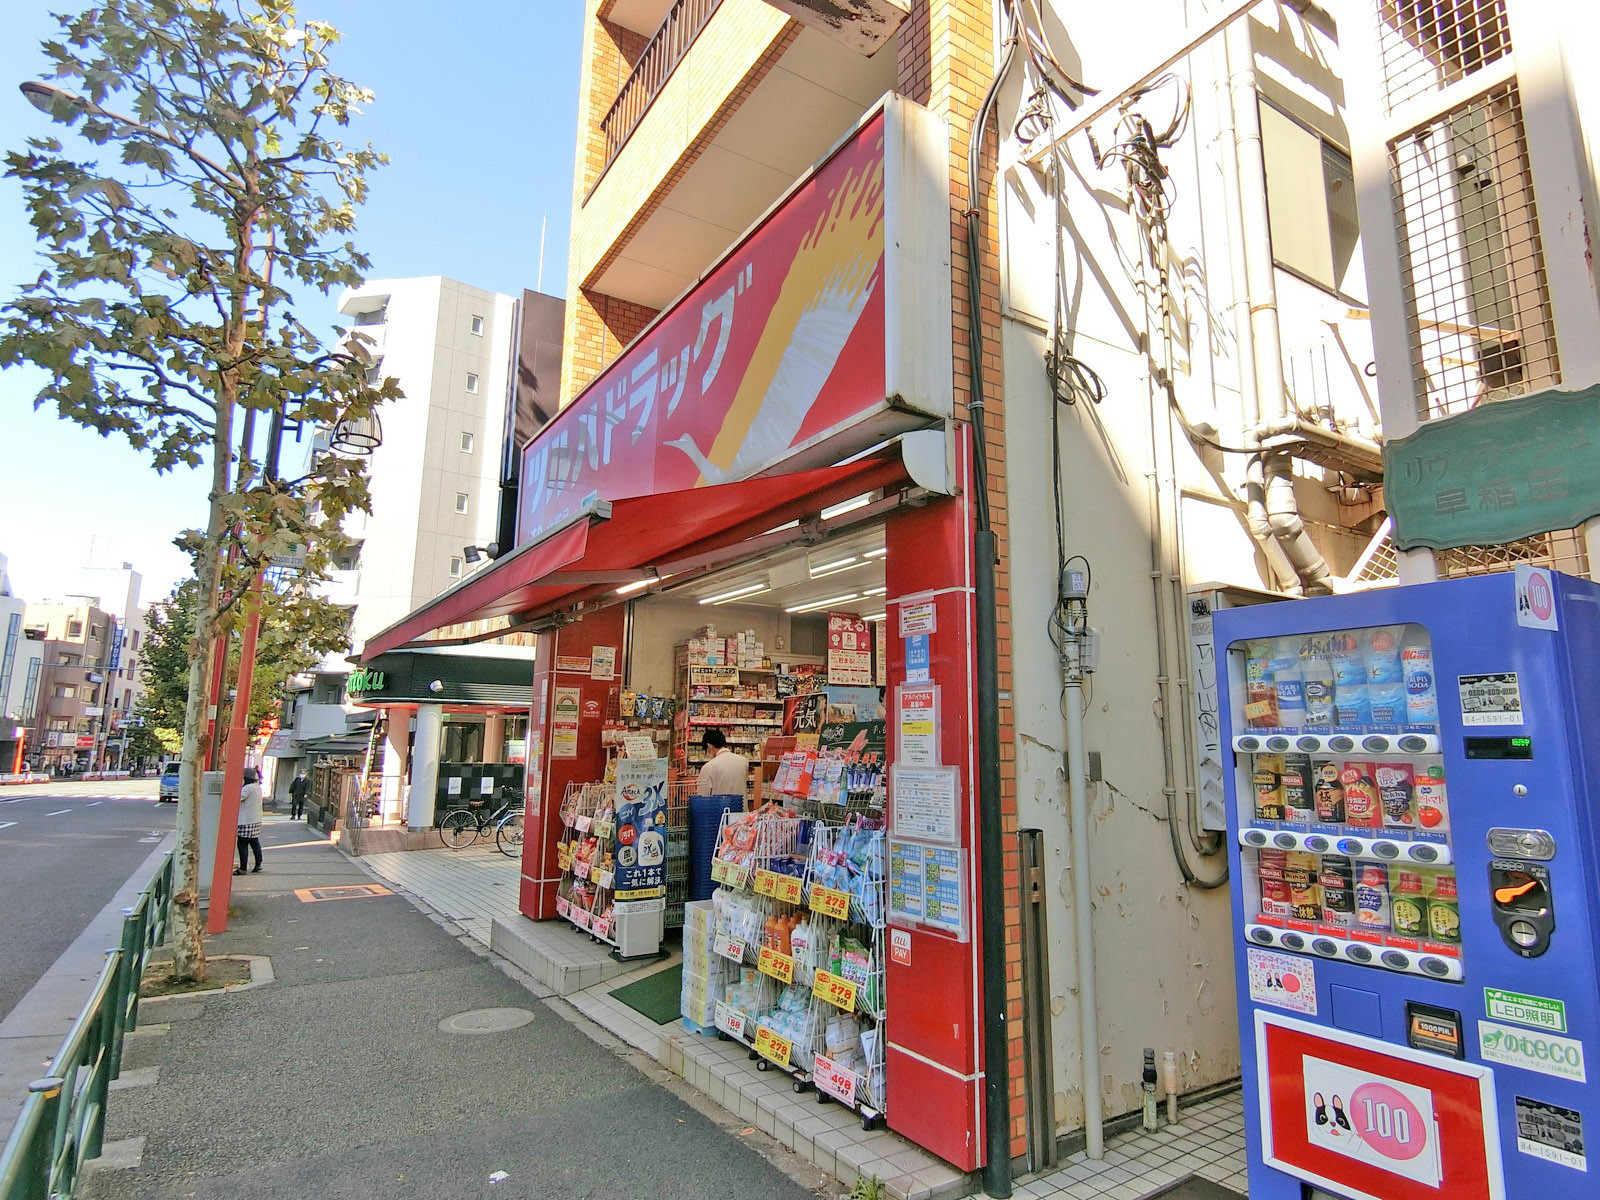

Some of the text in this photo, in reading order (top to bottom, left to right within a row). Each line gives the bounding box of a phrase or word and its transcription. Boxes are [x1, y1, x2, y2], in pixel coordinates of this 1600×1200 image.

[526, 262, 753, 514] ツルハドラッグ
[1435, 466, 1568, 519] 早稲田
[1531, 585, 1548, 608] 100
[1299, 634, 1347, 656] Asahi
[794, 709, 817, 729] 元気
[1465, 714, 1520, 723] 84-1591-01
[626, 868, 662, 878] これ1本で
[825, 896, 846, 909] 278
[1263, 901, 1273, 913] 朝
[830, 907, 842, 915] 305
[894, 936, 907, 947] au
[728, 944, 741, 955] 298
[894, 947, 907, 959] PAY
[772, 959, 791, 972] 278
[777, 970, 787, 979] 305
[830, 983, 852, 1000] 278
[835, 995, 848, 1006] 305
[1496, 1003, 1555, 1025] LED照明
[726, 1017, 741, 1029] 188
[1421, 1023, 1452, 1035] 1000円札
[770, 1039, 788, 1056] 278
[1504, 1034, 1580, 1067] のむeco
[774, 1050, 785, 1062] 305
[831, 1073, 852, 1091] 498
[836, 1085, 849, 1096] 547
[1362, 1098, 1410, 1144] 100
[1520, 1141, 1582, 1166] 84-1591-01
